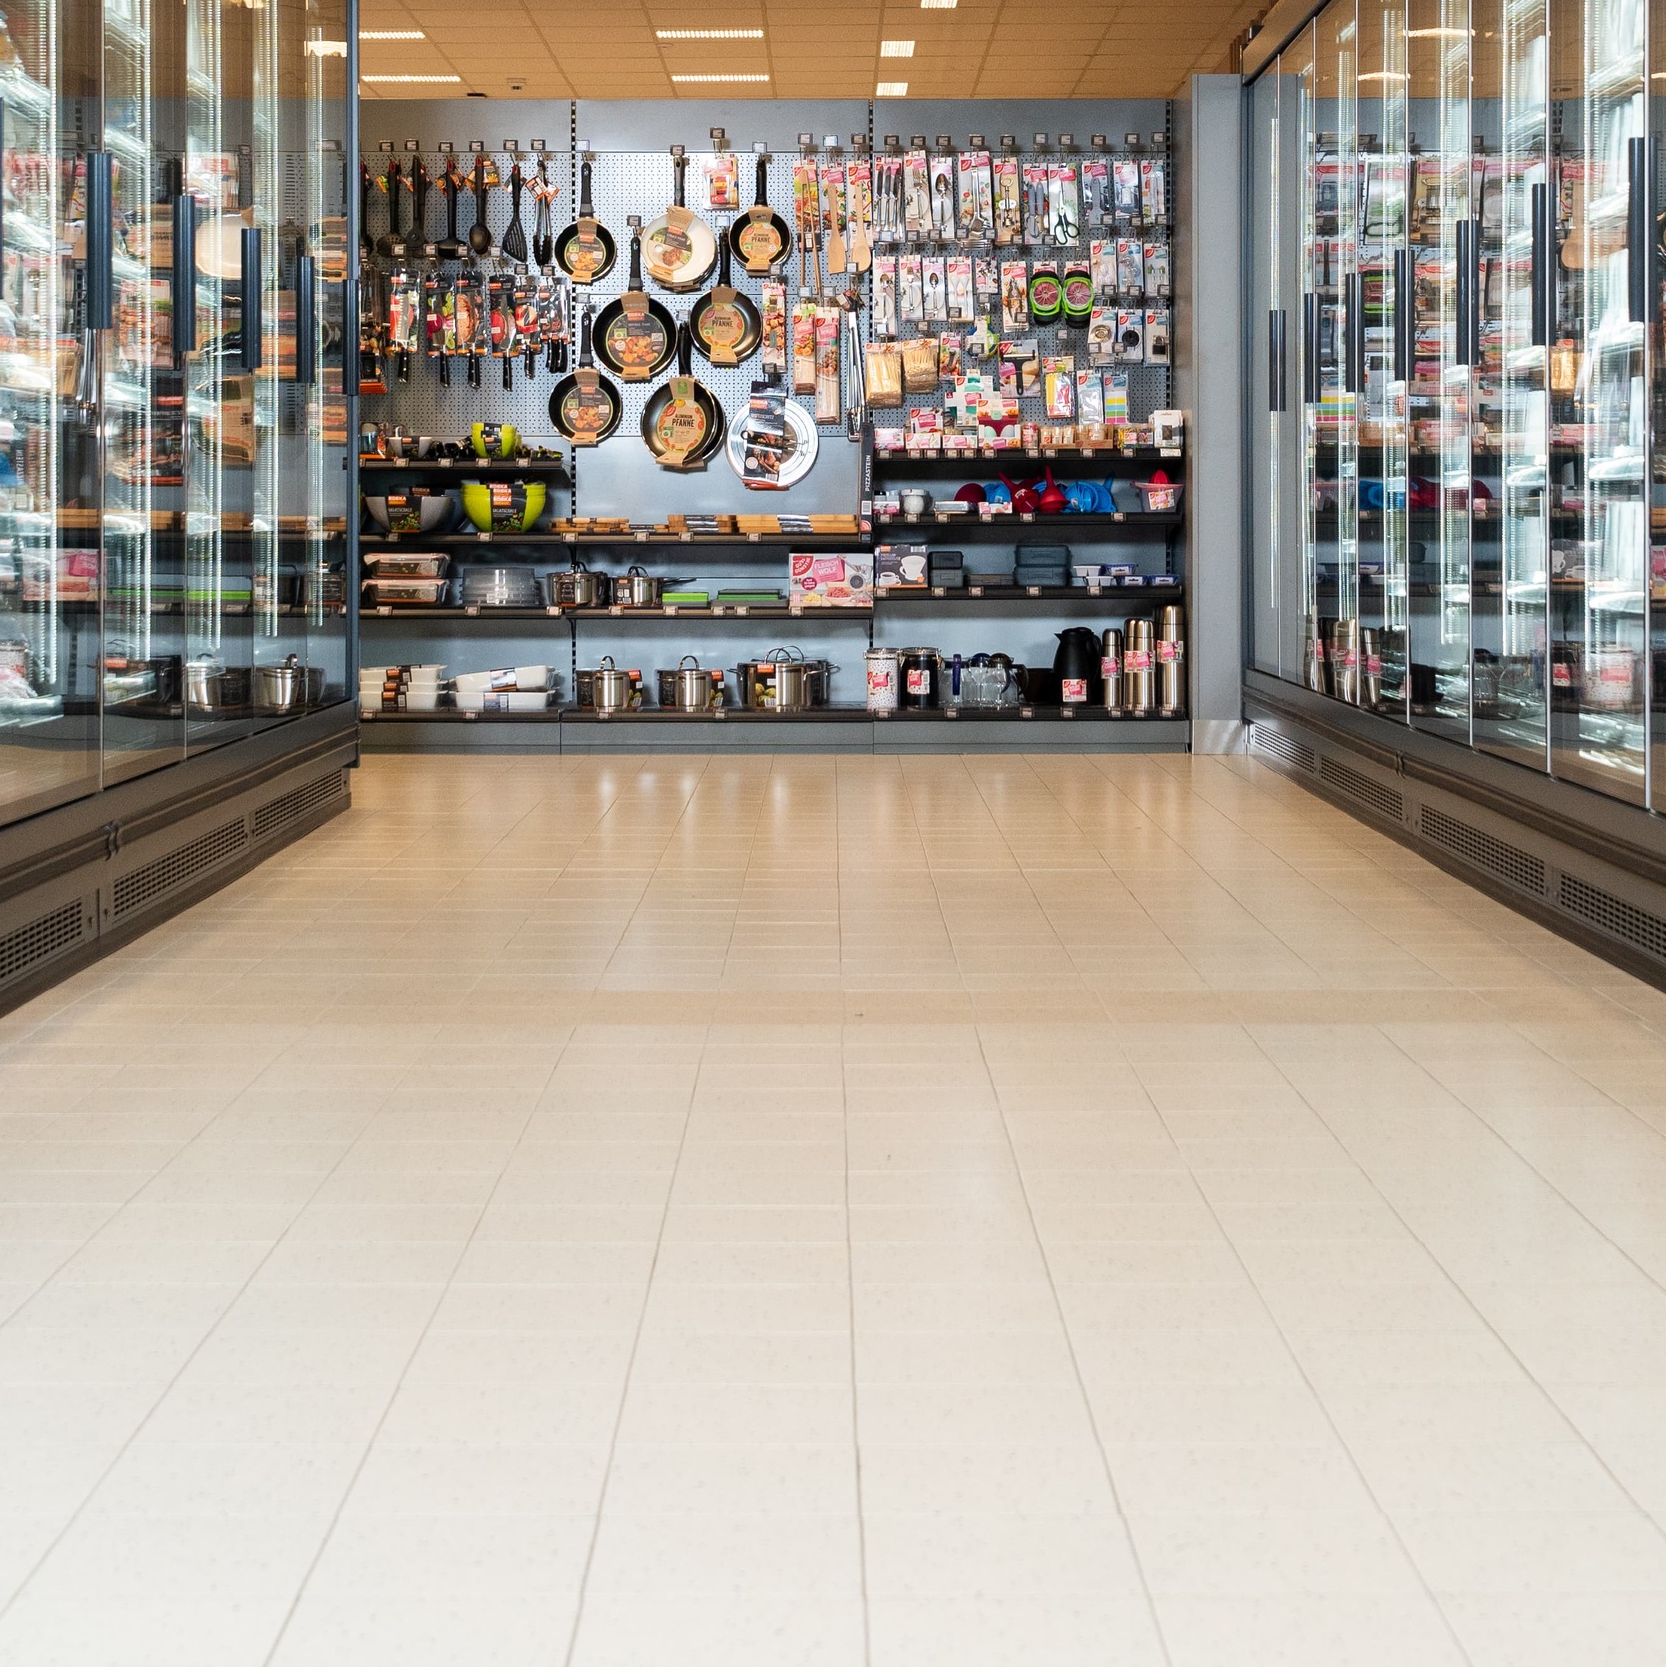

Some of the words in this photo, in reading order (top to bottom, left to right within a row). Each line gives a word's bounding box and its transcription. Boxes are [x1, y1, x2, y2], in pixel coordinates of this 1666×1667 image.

[672, 419, 695, 427] PFANNE
[814, 559, 839, 570] FLEISCH
[818, 566, 836, 575] WOLF
